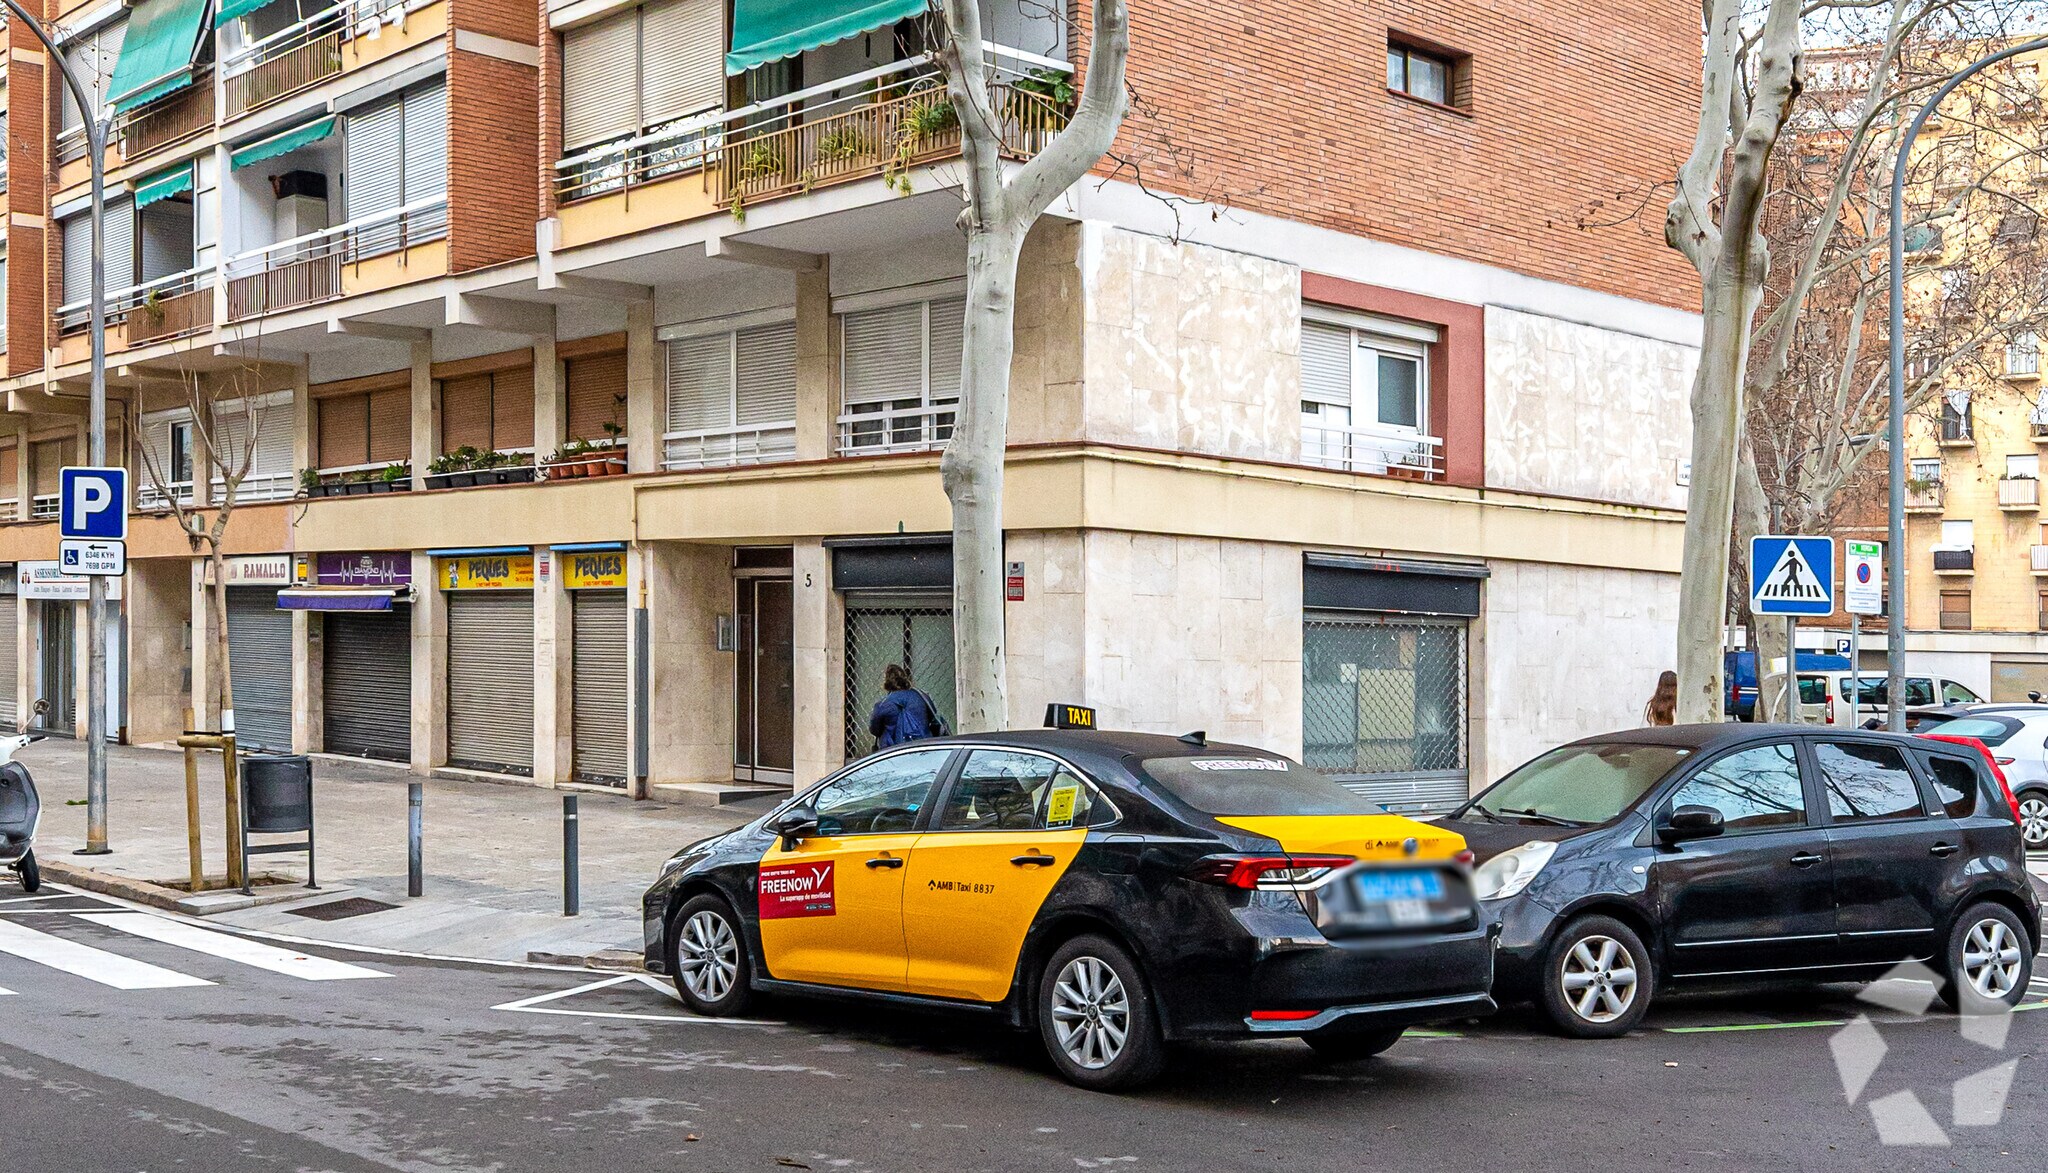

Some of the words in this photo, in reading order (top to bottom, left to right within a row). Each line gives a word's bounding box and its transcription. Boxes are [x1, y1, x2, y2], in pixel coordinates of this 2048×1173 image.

[73, 476, 112, 530] P
[101, 562, 116, 570] GPM
[244, 563, 286, 578] RAMALLO
[468, 558, 509, 581] PEQUES
[574, 556, 622, 580] PEQUES
[804, 573, 812, 588] 5
[1839, 640, 1849, 652] P
[1067, 707, 1091, 726] TAXI
[761, 876, 813, 894] FREENOW
[937, 881, 953, 890] AMB
[957, 882, 971, 892] Taxi
[974, 884, 995, 894] 8837
